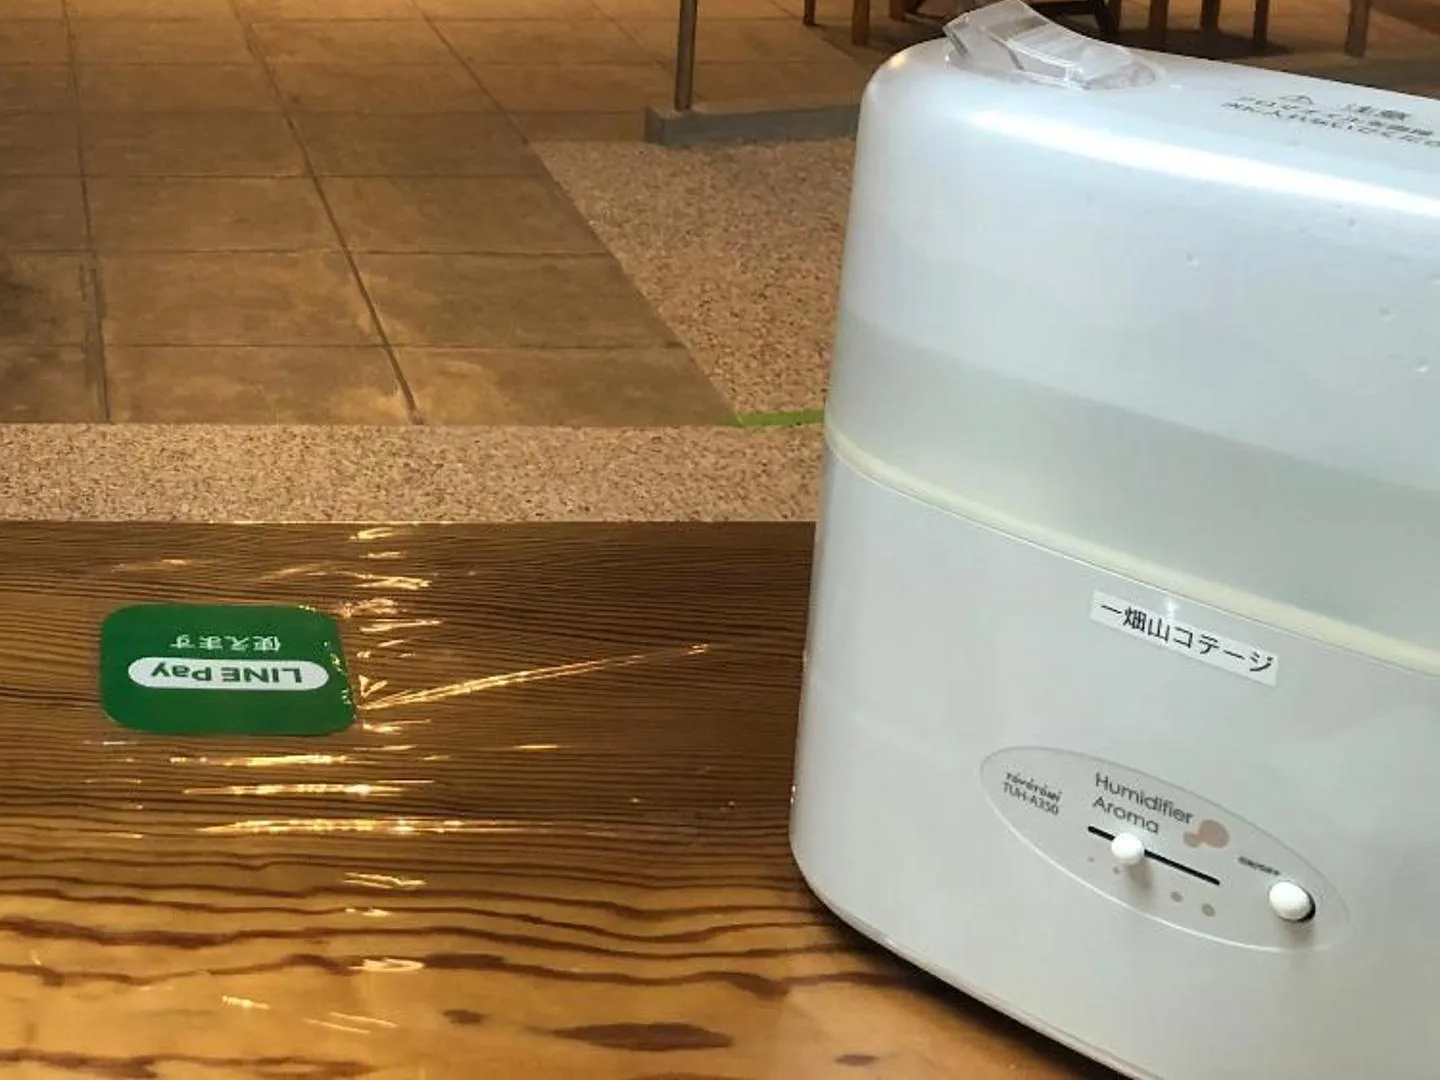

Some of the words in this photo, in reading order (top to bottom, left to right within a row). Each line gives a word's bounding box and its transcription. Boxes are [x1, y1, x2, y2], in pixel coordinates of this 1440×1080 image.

[168, 633, 282, 652] 使えます
[150, 661, 213, 682] Pay
[220, 666, 303, 683] LINE
[1094, 771, 1194, 825] Humidifier
[1091, 796, 1160, 834] Aroma
